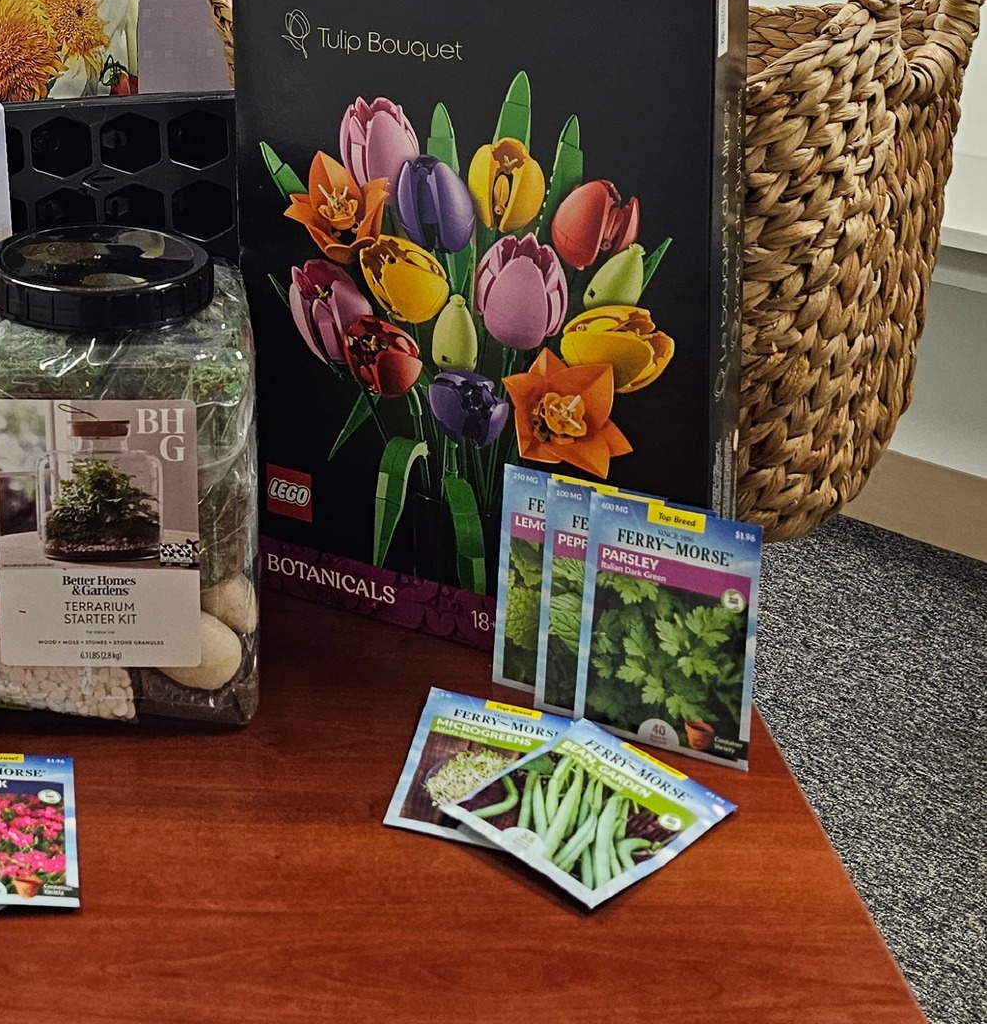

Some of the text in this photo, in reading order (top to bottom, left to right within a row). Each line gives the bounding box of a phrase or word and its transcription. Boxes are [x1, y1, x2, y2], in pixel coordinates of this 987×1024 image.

[316, 26, 463, 62] Tulip Bouquet
[136, 408, 186, 434] BH
[159, 435, 186, 462] G
[526, 475, 538, 484] MG
[269, 478, 310, 505] LEGO
[556, 489, 582, 501] 100 MG
[615, 505, 629, 514] MG
[658, 512, 696, 527] Top Breed
[735, 530, 756, 543] $1.96
[602, 547, 659, 571] PARSLEY
[62, 575, 137, 586] Better Homes
[267, 553, 396, 604] BOTANICALS
[601, 560, 667, 583] Italian Dark Green
[64, 601, 135, 612] TERRARIUM
[64, 613, 137, 624] STARTER KIT
[436, 717, 532, 747] MICROGREENS
[652, 724, 666, 736] 40
[560, 739, 596, 766] BEAN,
[598, 764, 653, 799] GARDEN
